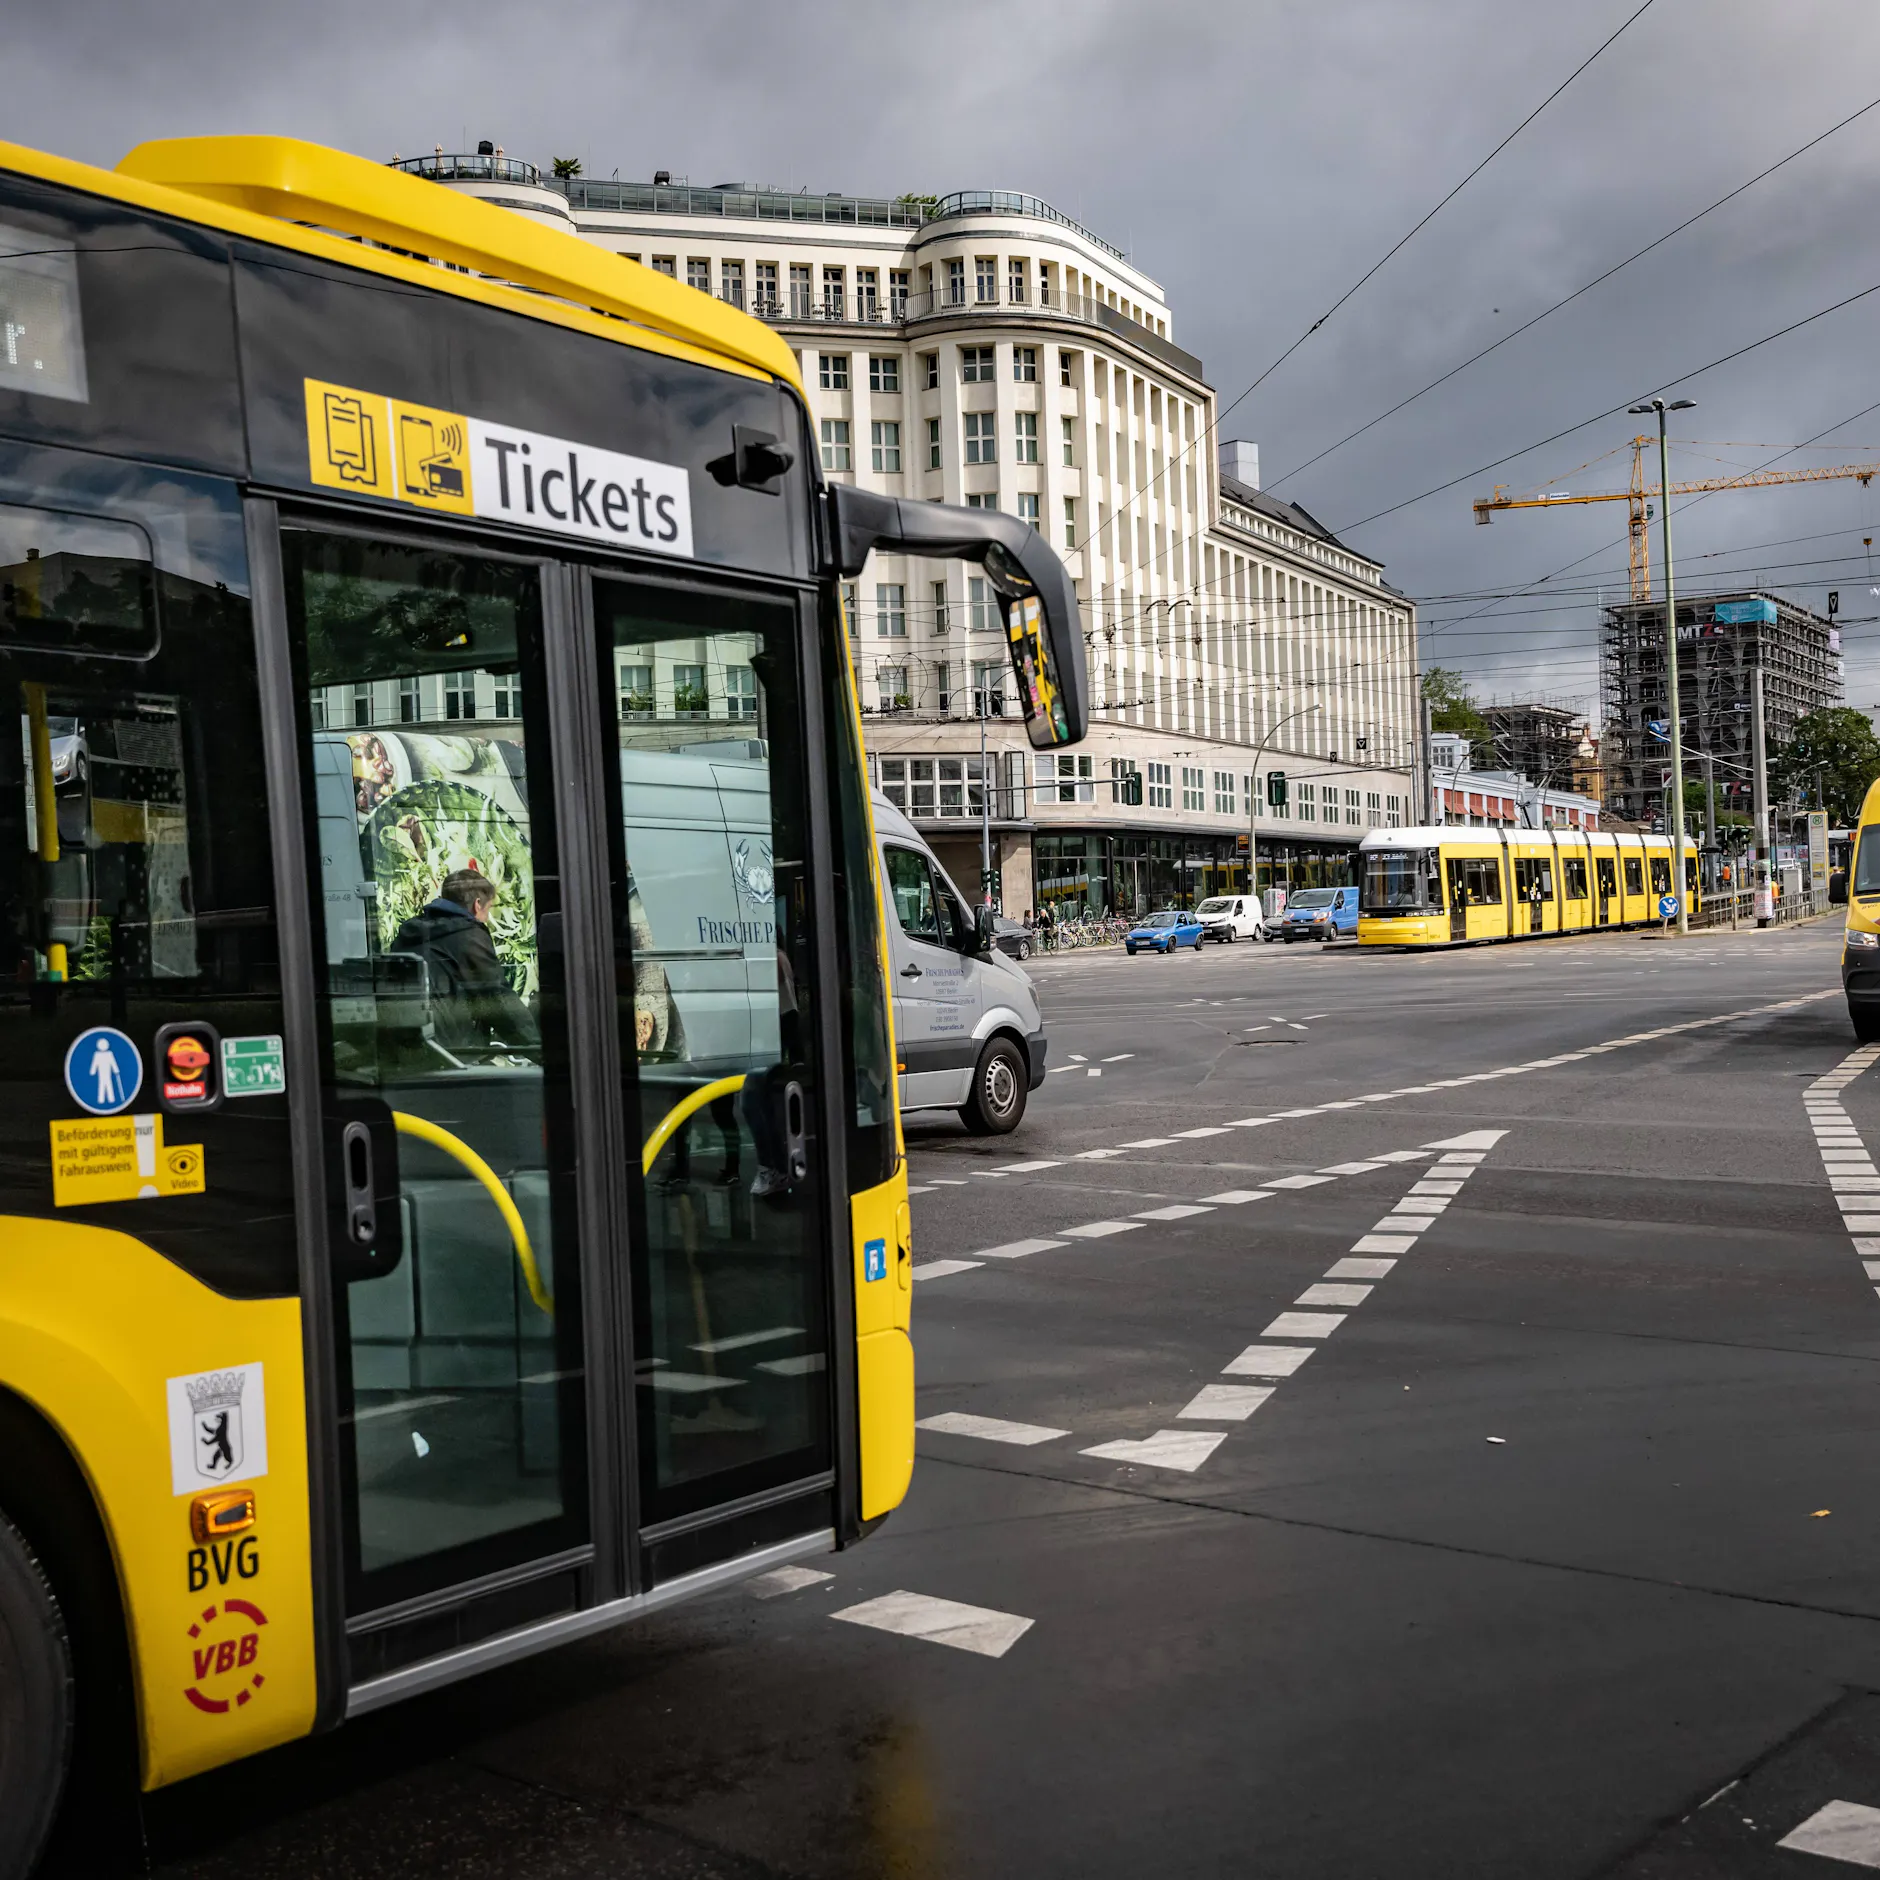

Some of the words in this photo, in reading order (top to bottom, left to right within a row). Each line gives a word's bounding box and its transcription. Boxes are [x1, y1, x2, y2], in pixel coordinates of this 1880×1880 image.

[485, 436, 679, 542] Tickets
[342, 893, 352, 902] 48
[697, 916, 777, 944] FRISCHEP
[57, 1126, 132, 1143] Beförderung
[134, 1125, 154, 1137] nur
[58, 1147, 78, 1159] mit
[81, 1144, 135, 1161] gültigem
[59, 1160, 133, 1177] Fahrausweis
[170, 1178, 199, 1190] Video
[187, 1536, 260, 1593] BVG
[192, 1632, 260, 1681] VBB
